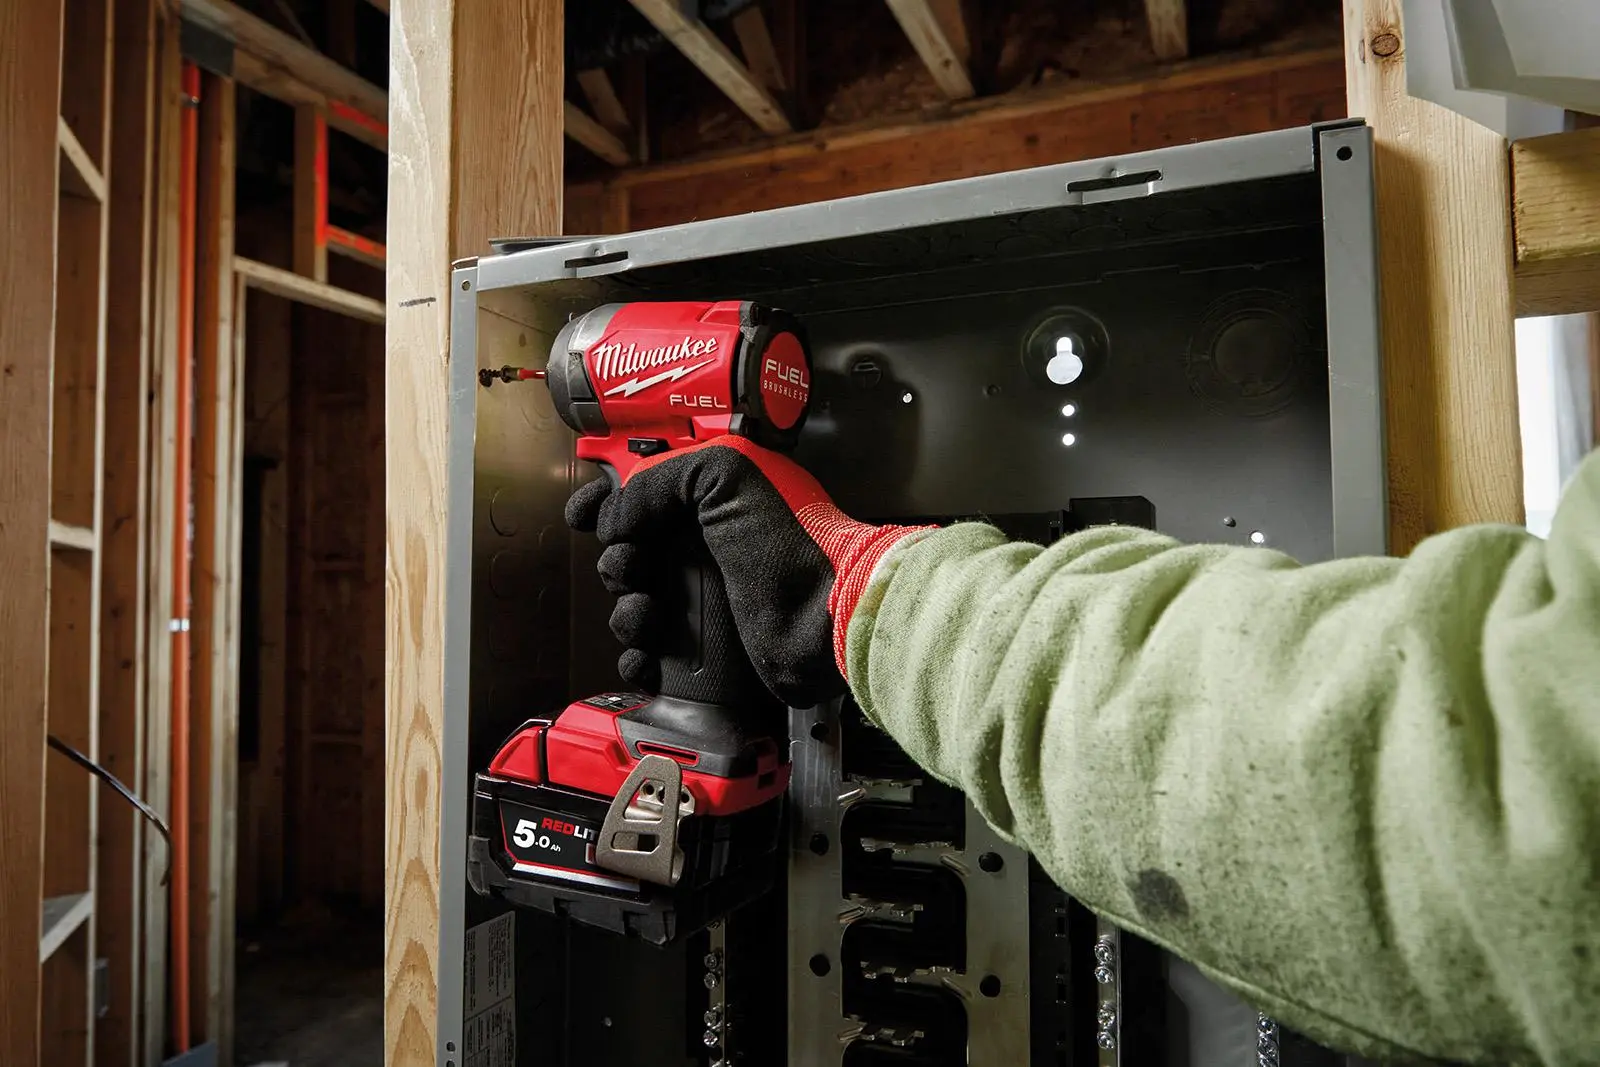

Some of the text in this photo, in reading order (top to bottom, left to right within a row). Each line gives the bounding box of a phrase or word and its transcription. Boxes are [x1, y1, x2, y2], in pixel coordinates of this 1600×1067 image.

[592, 336, 719, 381] Milwaukee
[764, 358, 809, 389] FUEL
[669, 394, 728, 409] FUEL
[763, 379, 808, 403] BRUSHLESS
[512, 818, 561, 852] 5.0 Ah
